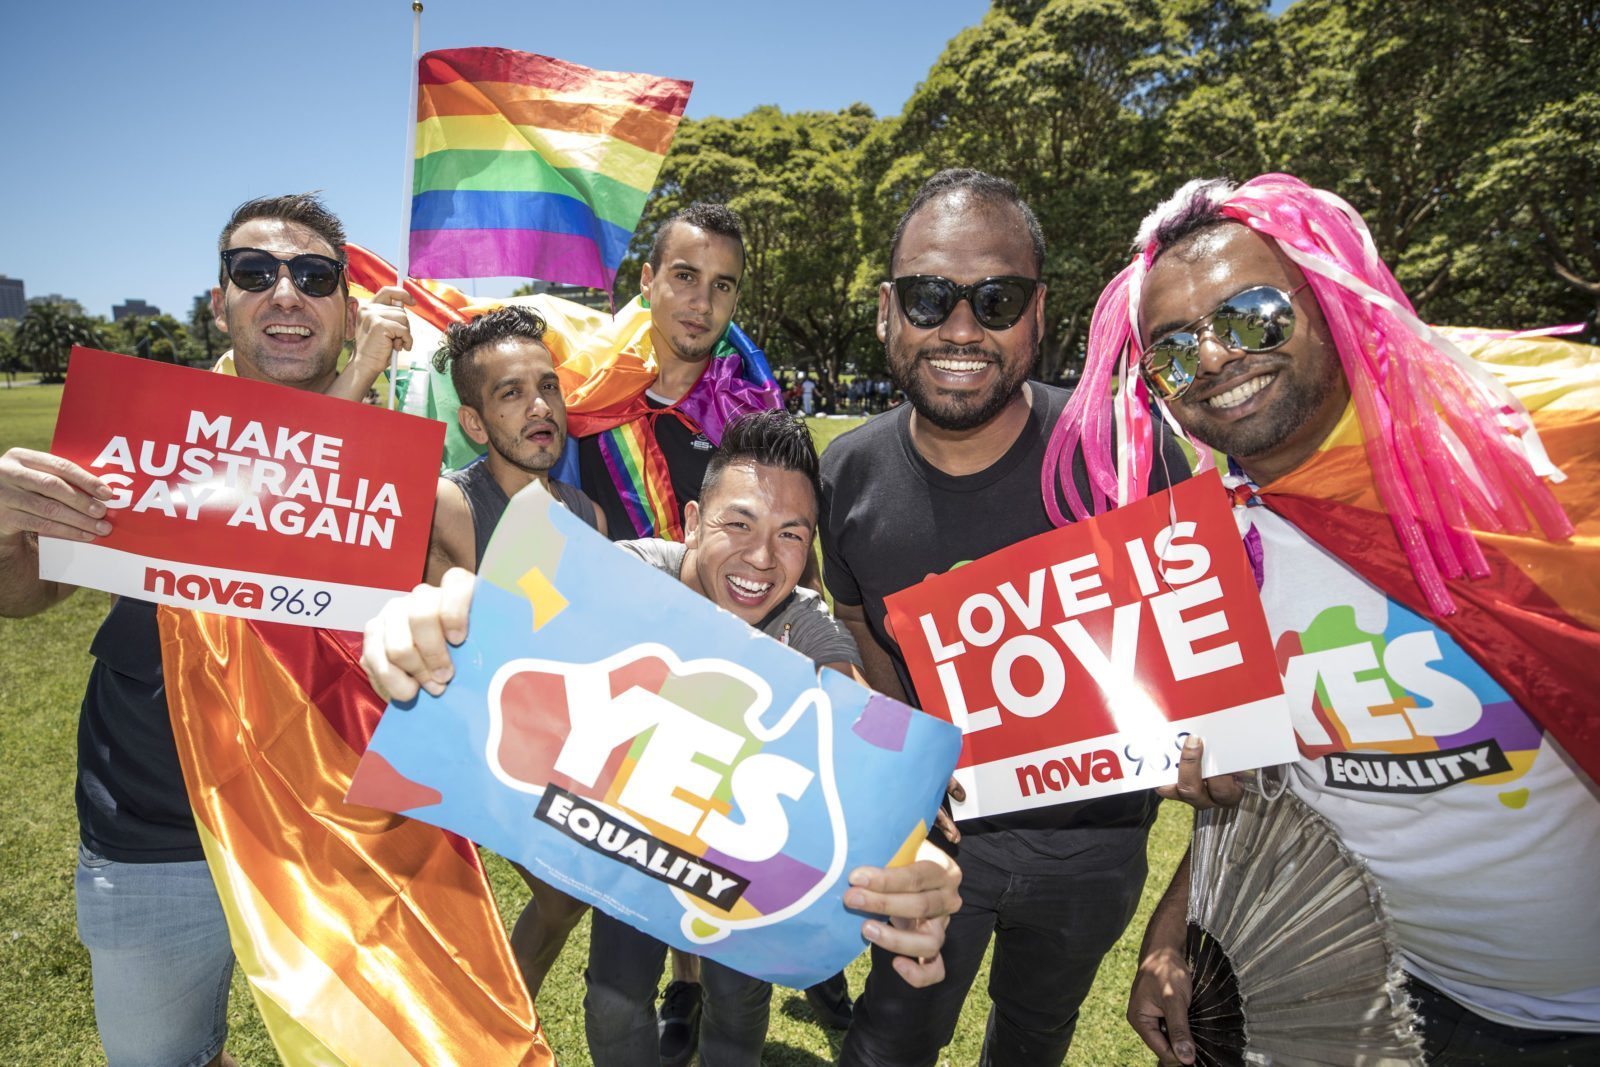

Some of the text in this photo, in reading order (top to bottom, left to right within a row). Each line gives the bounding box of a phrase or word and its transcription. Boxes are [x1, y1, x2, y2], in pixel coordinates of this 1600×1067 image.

[90, 435, 402, 517] AUSTRALIA
[186, 410, 343, 470] MAKE
[93, 473, 397, 550] GAY AGAIN
[143, 567, 332, 617] nova 96.9
[919, 521, 1211, 663] LOVE IS
[936, 576, 1244, 735] LOVE
[1284, 630, 1483, 746] YES
[554, 674, 815, 862] YES
[1016, 748, 1124, 797] nova
[1330, 747, 1491, 788] EQUALITY
[546, 795, 740, 901] EQUALITY
